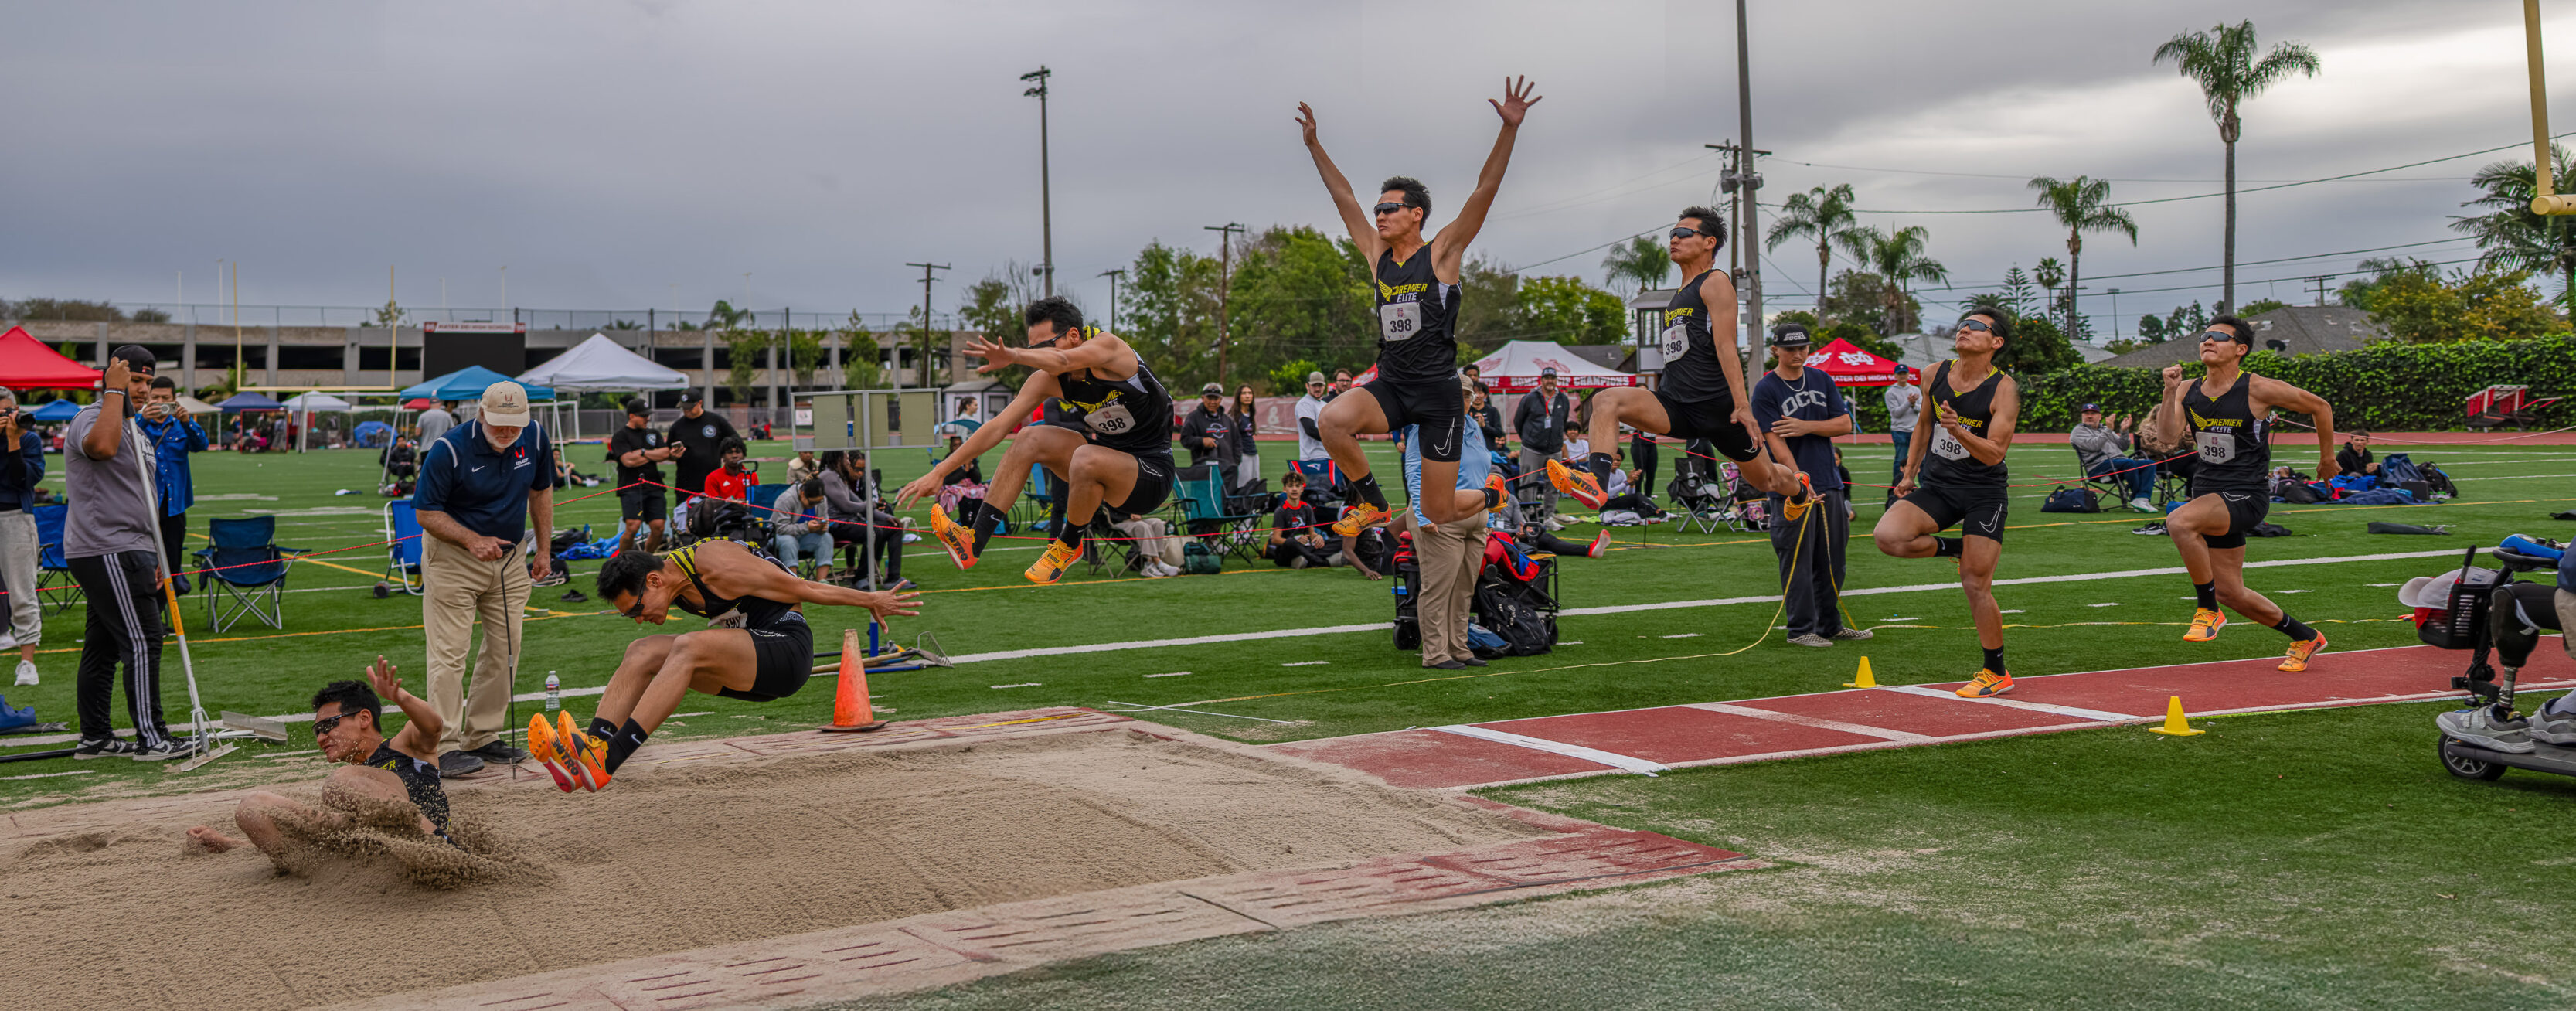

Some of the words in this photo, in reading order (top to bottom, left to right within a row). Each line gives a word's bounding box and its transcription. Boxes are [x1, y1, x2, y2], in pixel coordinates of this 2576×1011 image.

[1392, 283, 1428, 296] PREMIER
[1397, 292, 1417, 303] ELITE
[1390, 318, 1412, 333] 398
[1666, 340, 1682, 356] 398
[1574, 376, 1629, 386] CHAMPIONS
[1781, 390, 1827, 417] OCC
[1098, 417, 1126, 432] 398
[1939, 438, 1962, 455] 398
[2204, 445, 2225, 458] 398
[944, 526, 968, 560] NITRO
[1046, 553, 1059, 563] PUMA
